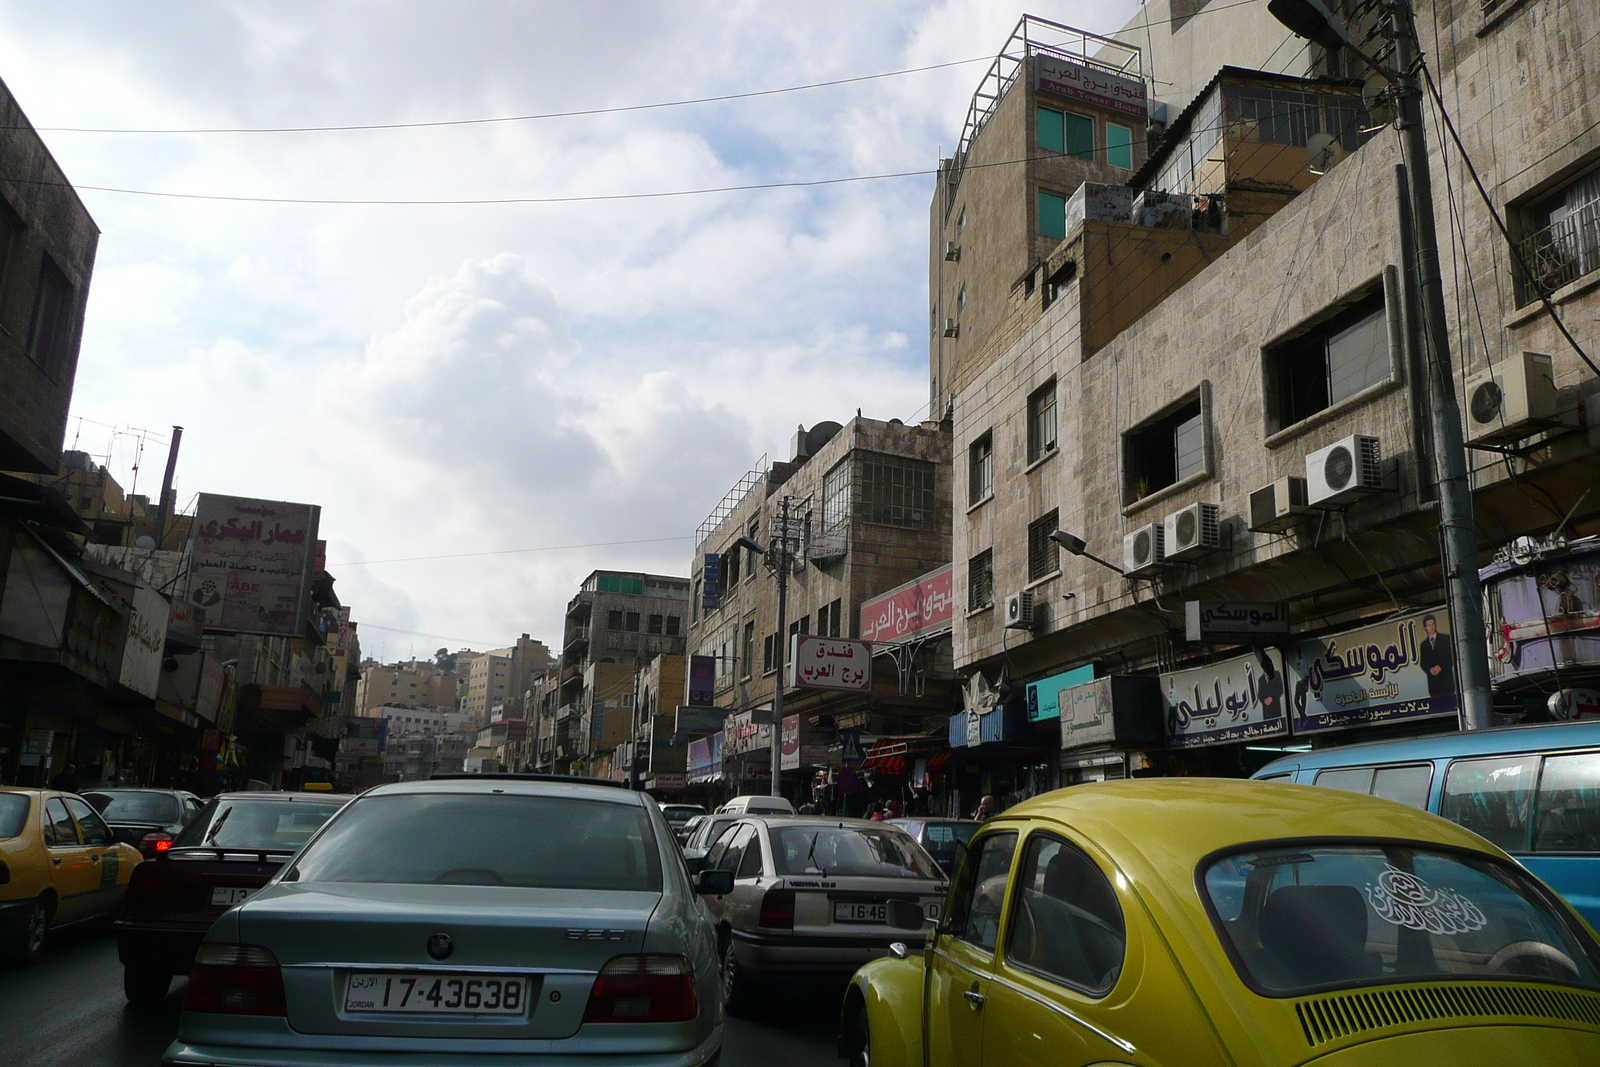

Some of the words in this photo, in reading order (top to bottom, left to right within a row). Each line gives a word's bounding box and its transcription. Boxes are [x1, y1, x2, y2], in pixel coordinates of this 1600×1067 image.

[1042, 68, 1080, 81] العرب
[1083, 76, 1108, 93] برج
[1110, 82, 1145, 100] فندق
[1048, 82, 1073, 95] Arab
[1077, 91, 1110, 105] Tower
[1114, 101, 1141, 114] Hotel
[199, 517, 262, 544] البكري
[262, 522, 305, 546] عمار
[923, 578, 953, 621] ندق
[862, 598, 895, 641] العرب
[896, 599, 921, 634] برج
[1201, 602, 1285, 627] الموسكي
[816, 642, 854, 659] فندق
[1309, 619, 1419, 701] الموسكي
[804, 664, 835, 681] العرب
[842, 666, 864, 685] برج
[1335, 689, 1367, 707] الجاهزة
[1369, 682, 1399, 701] للألبسة
[1358, 709, 1391, 721] سبورات
[1399, 701, 1430, 714] بدلات
[1318, 714, 1350, 726] جينزات
[1219, 731, 1239, 741] بدلات
[929, 904, 939, 917] D
[351, 977, 378, 989] الاردن
[349, 1001, 375, 1009] JORDAN
